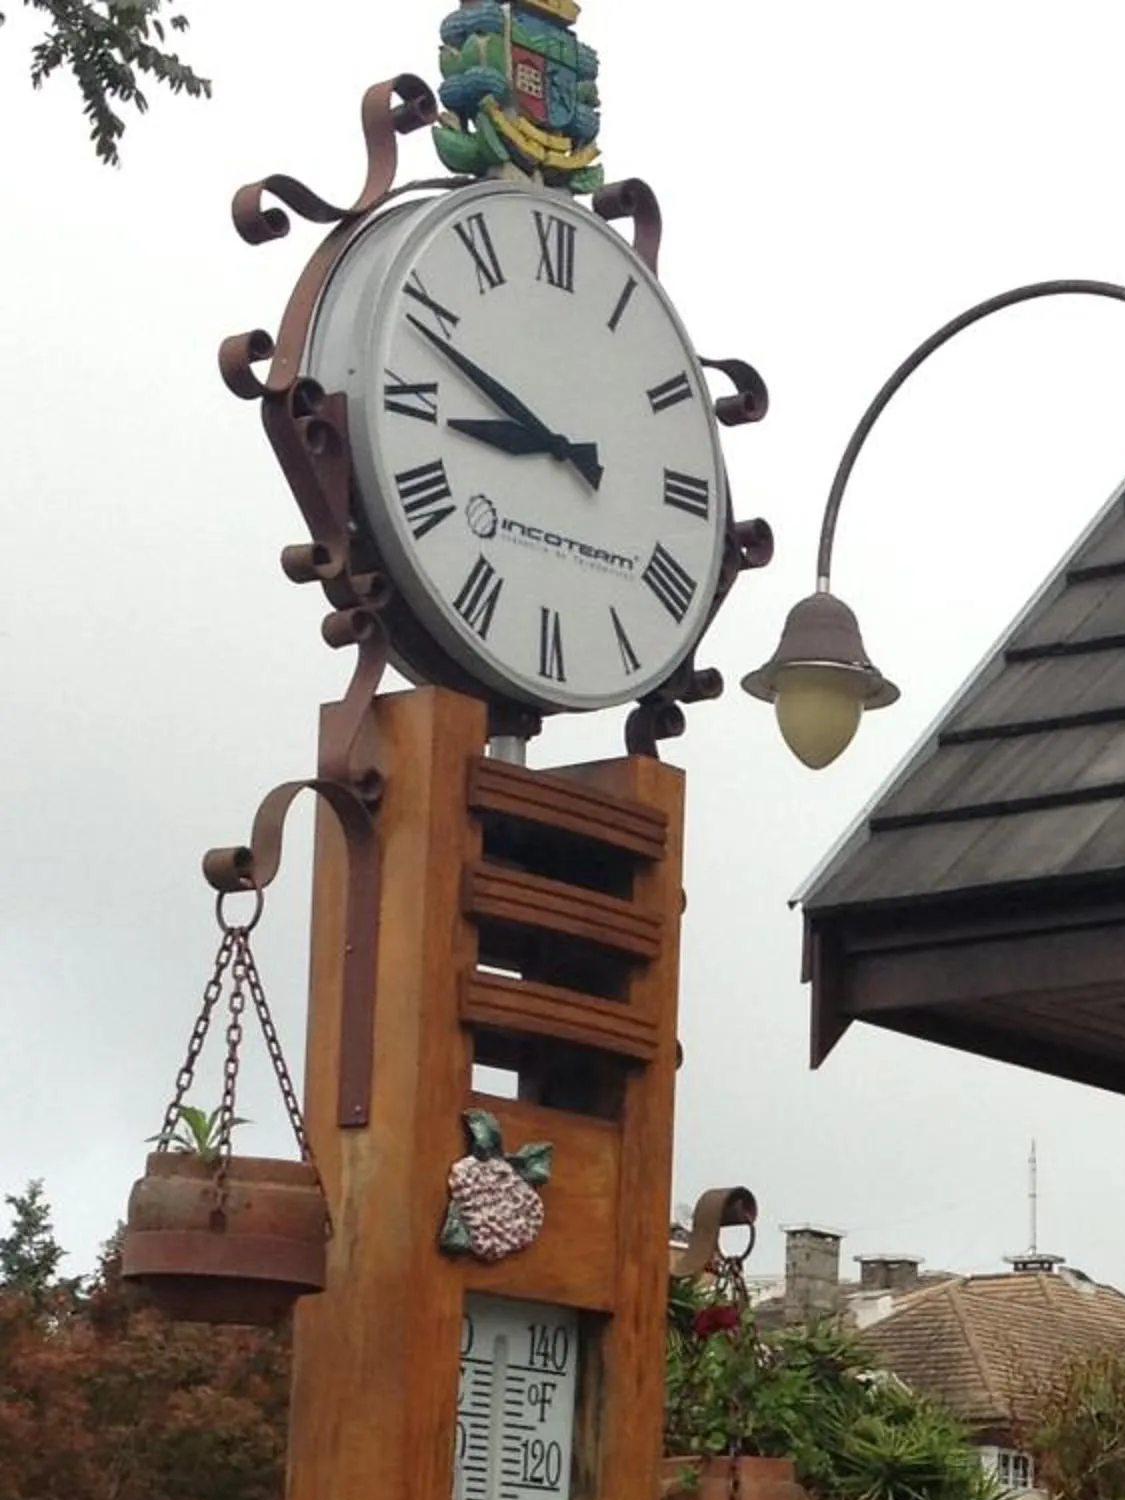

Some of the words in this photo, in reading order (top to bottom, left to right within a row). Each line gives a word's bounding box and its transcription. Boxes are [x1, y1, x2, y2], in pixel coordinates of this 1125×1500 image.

[454, 212, 507, 294] XI
[533, 211, 577, 293] XII
[403, 270, 461, 340] X
[607, 274, 638, 331] I
[384, 368, 439, 424] IX
[646, 371, 693, 414] II
[395, 458, 457, 540] VIII
[664, 467, 709, 520] III
[453, 553, 504, 640] VII
[538, 606, 567, 682] VI
[610, 606, 641, 675] V
[527, 1323, 568, 1371] 140
[520, 1439, 561, 1486] 120
